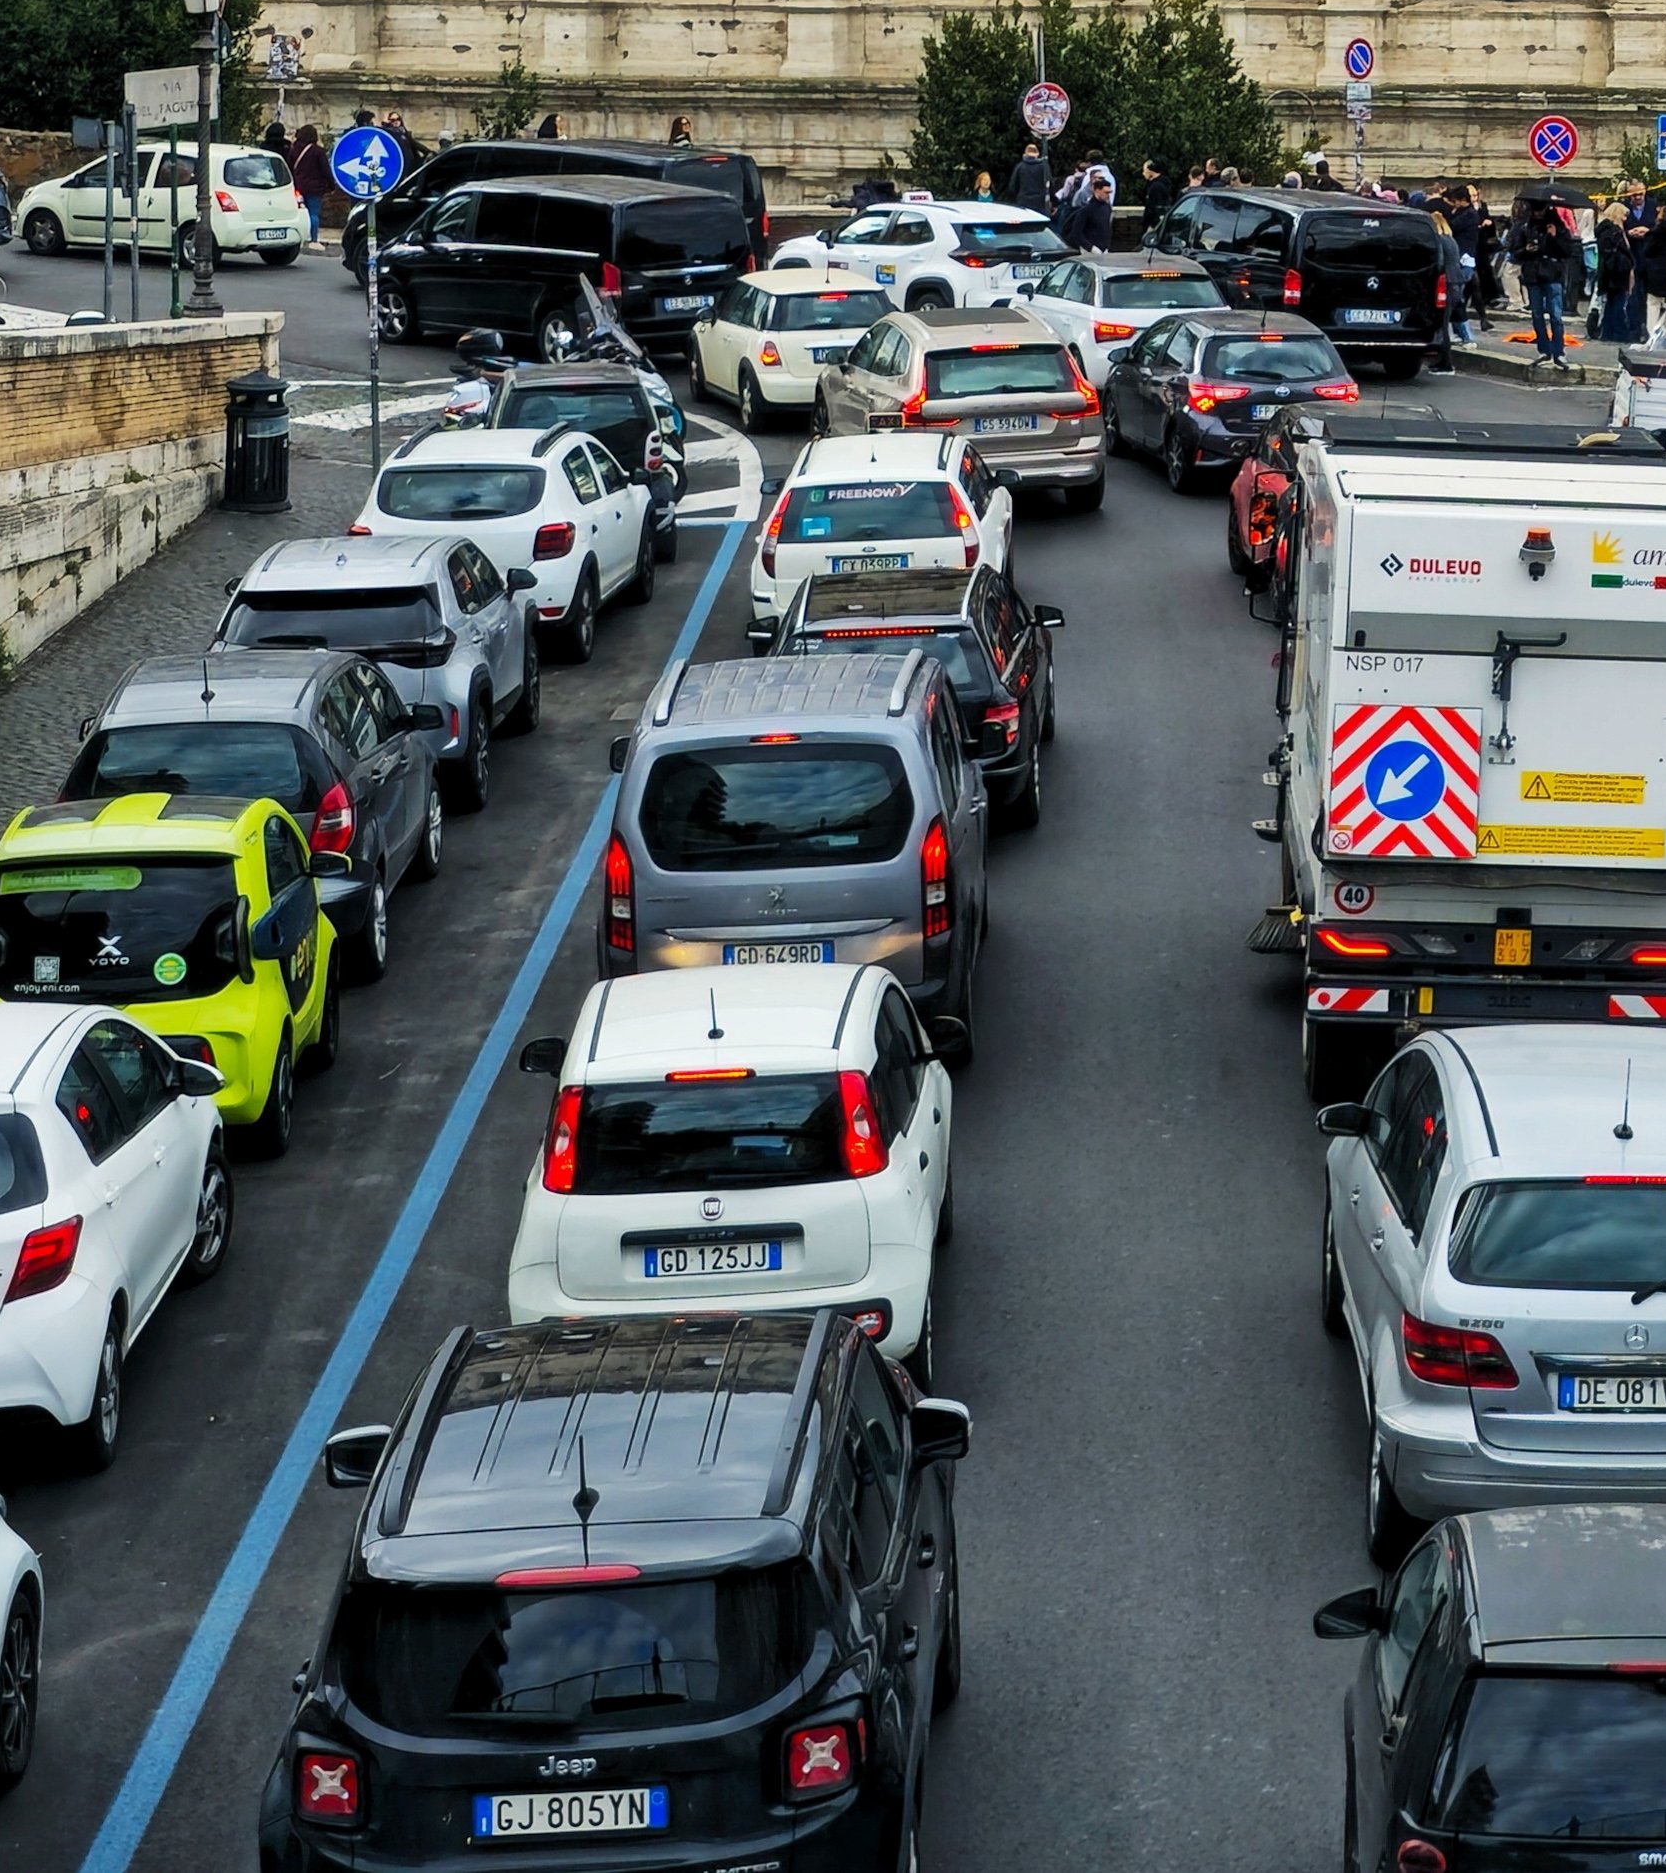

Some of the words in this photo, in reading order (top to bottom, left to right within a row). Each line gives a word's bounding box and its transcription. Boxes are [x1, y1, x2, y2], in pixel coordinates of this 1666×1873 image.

[828, 488, 896, 500] FREENOW
[1410, 558, 1481, 575] DULEVO
[1346, 655, 1386, 671] NSP
[1394, 657, 1424, 673] 017
[1344, 888, 1365, 903] 40
[89, 957, 130, 966] YOYO
[737, 946, 758, 964] GD
[765, 945, 821, 963] 649RD
[14, 983, 80, 995] enjoy.eni.com
[661, 1249, 688, 1272] GD
[698, 1244, 766, 1271] 125JJ
[1578, 1379, 1606, 1404] DE
[538, 1755, 598, 1777] Jeep
[497, 1799, 534, 1831] GJ
[547, 1791, 647, 1828] 805YN
